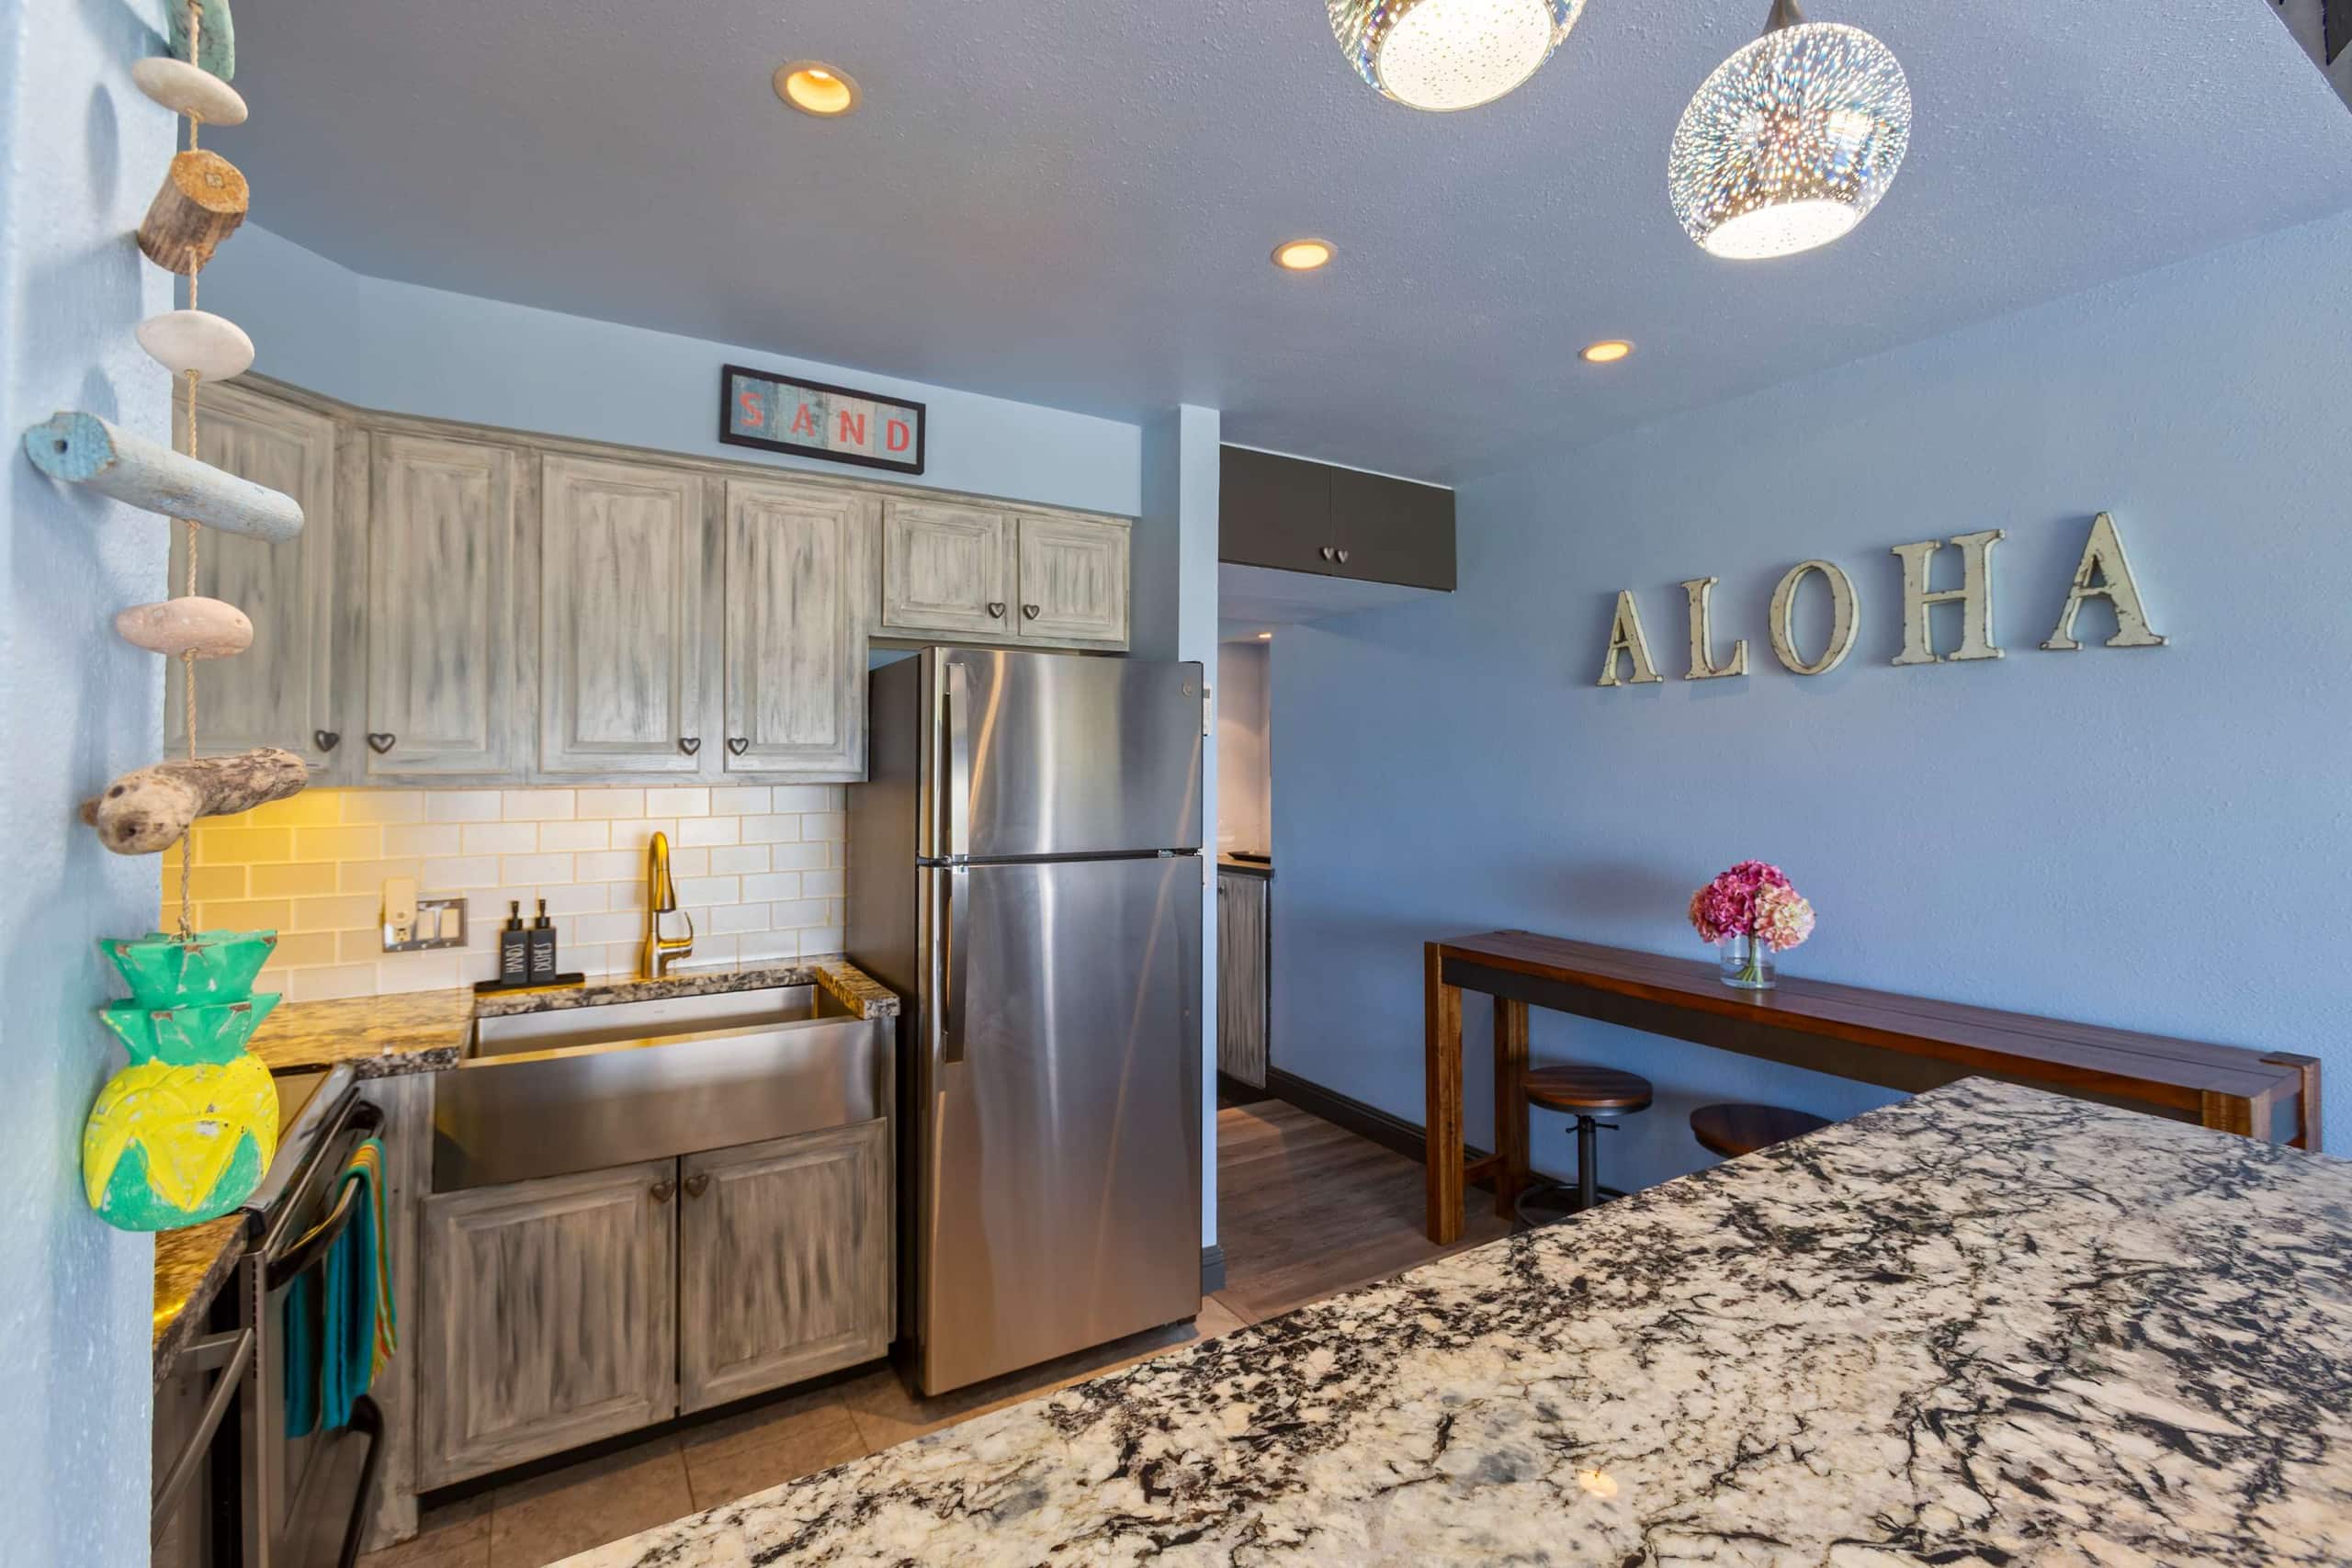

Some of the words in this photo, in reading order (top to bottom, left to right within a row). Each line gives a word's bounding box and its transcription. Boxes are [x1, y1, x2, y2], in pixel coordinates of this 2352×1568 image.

[739, 391, 910, 451] SAND
[1596, 511, 2169, 686] ALOHA
[505, 943, 524, 973] HANDS
